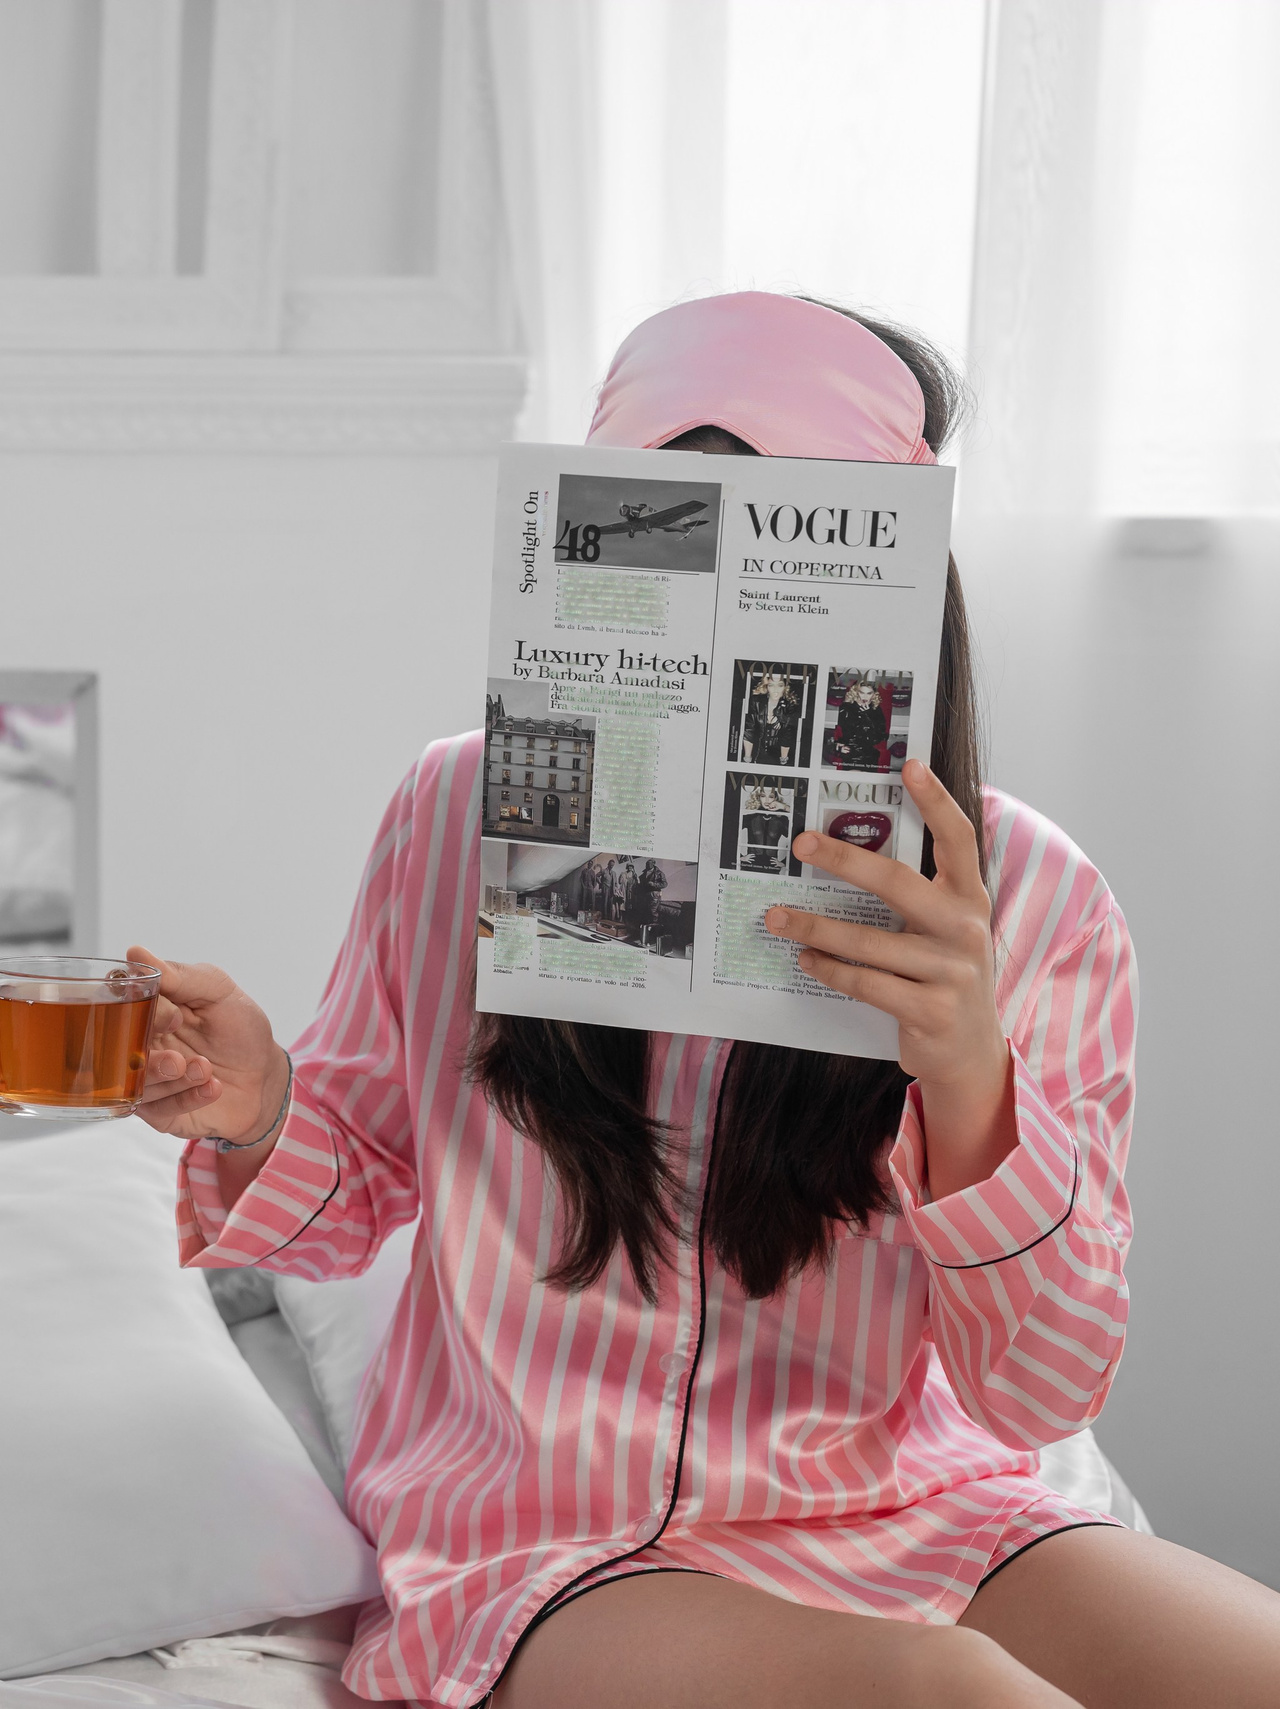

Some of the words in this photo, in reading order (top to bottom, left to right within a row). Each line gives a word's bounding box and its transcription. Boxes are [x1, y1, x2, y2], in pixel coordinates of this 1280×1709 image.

[523, 490, 539, 514] On
[743, 503, 897, 548] VOGUE
[552, 520, 601, 562] 48
[519, 519, 540, 594] Spotlight
[742, 558, 765, 573] IN
[770, 560, 884, 580] COPERTINA
[738, 600, 752, 611] by
[755, 601, 794, 613] Steven
[797, 604, 829, 615] Klein
[739, 588, 771, 600] Saint
[775, 591, 822, 603] Laurent
[514, 640, 610, 672] Luxury
[617, 648, 710, 676] hi-tech
[513, 663, 533, 680] by
[537, 665, 605, 684] Barbara
[610, 671, 686, 690] Amadasi
[736, 660, 818, 685] VOGUE
[830, 666, 913, 690] VOGUE
[551, 682, 576, 694] Apre
[642, 690, 683, 702] palazzo
[550, 700, 568, 710] Fra
[662, 701, 701, 714] viaggio.
[729, 771, 809, 797] VOGUE
[821, 780, 904, 806] VOGUE
[806, 884, 831, 893] pose!
[843, 909, 858, 917] Yves
[859, 911, 875, 919] Saint
[797, 988, 805, 996] by
[806, 990, 823, 998] Noah
